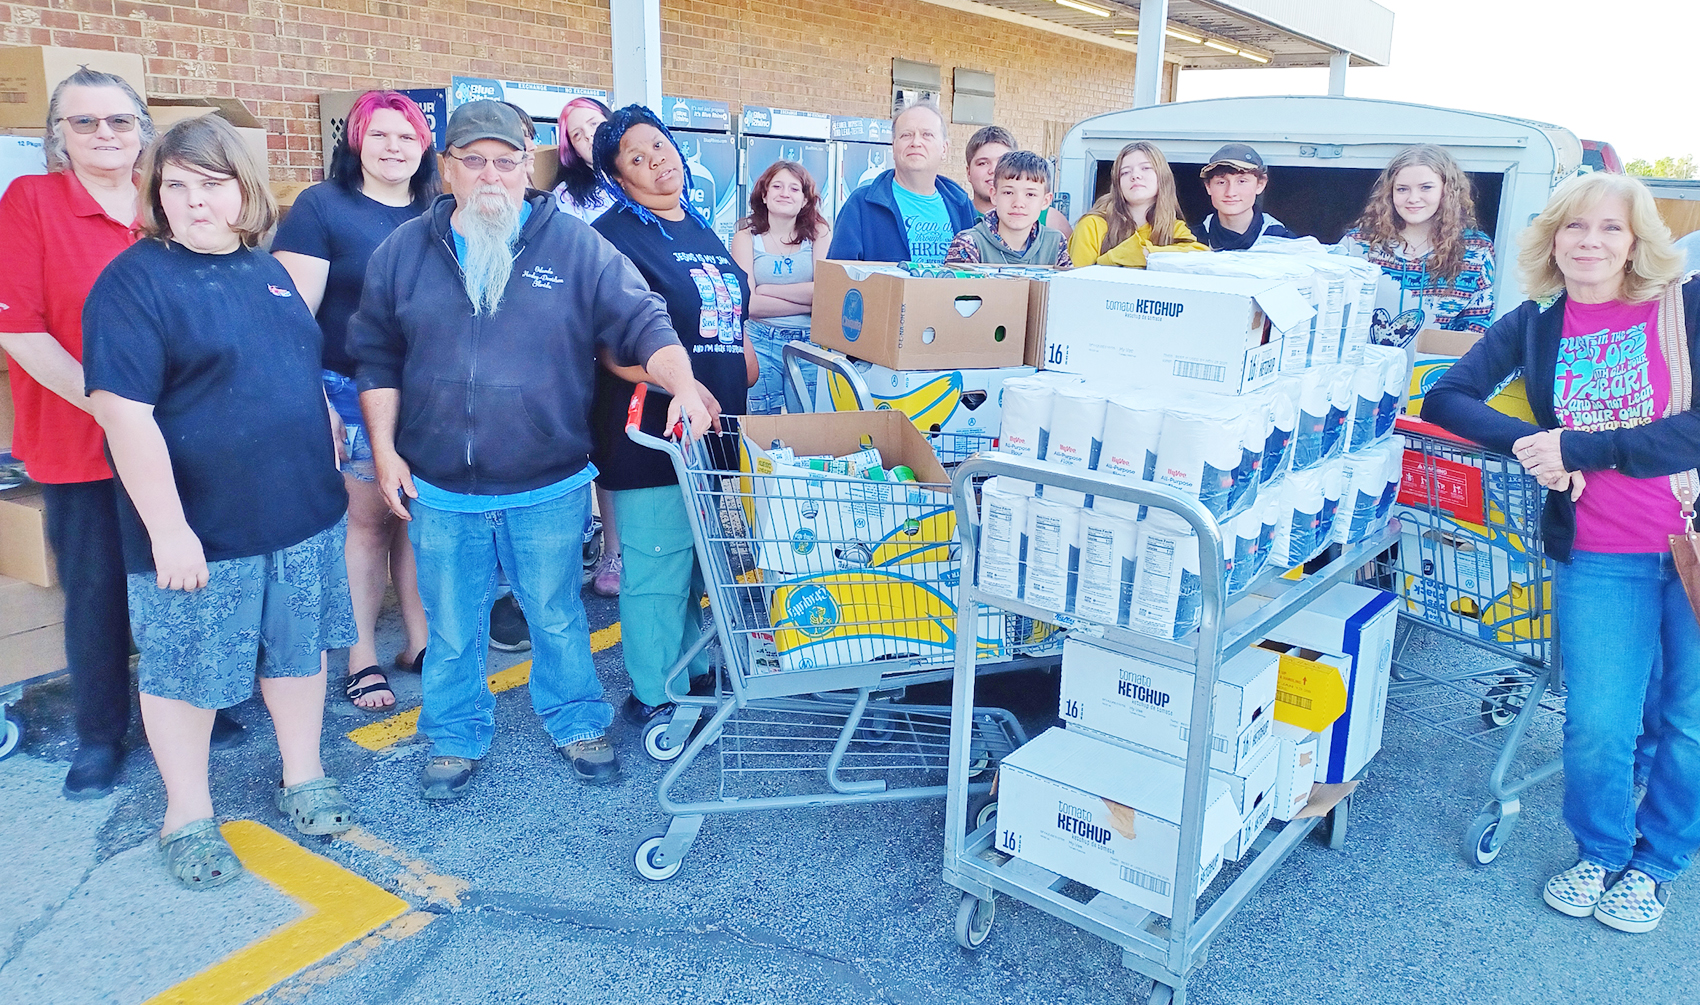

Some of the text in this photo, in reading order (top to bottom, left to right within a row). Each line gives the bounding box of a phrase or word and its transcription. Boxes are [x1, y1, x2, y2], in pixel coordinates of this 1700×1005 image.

[470, 84, 495, 95] Blue
[518, 83, 547, 91] EXCHANGE
[573, 87, 600, 96] EXCHANGE
[914, 221, 939, 232] can
[1106, 298, 1184, 318] tomato KETCHUP
[1048, 342, 1063, 365] 16
[1557, 331, 1602, 363] RUST
[1611, 331, 1626, 342] THE
[1591, 327, 1648, 369] LORD
[1259, 358, 1276, 377] KETCHUP
[1576, 361, 1649, 401] HEART
[1568, 399, 1591, 412] AND
[1605, 398, 1623, 410] NOT
[1571, 408, 1616, 426] YOUR
[1618, 398, 1655, 421] OWN
[1005, 442, 1031, 452] All-Purpose
[1053, 450, 1083, 462] All-Purpose
[1105, 463, 1136, 475] All-Purpose
[1160, 475, 1193, 487] All-Purpose
[787, 587, 828, 620] Chiquita
[1119, 668, 1152, 687] tomato
[1118, 680, 1170, 708] KETCHUP
[1065, 699, 1079, 718] 16
[1058, 800, 1093, 823] tomato
[1057, 812, 1112, 846] KETCHUP
[1002, 829, 1016, 851] 16
